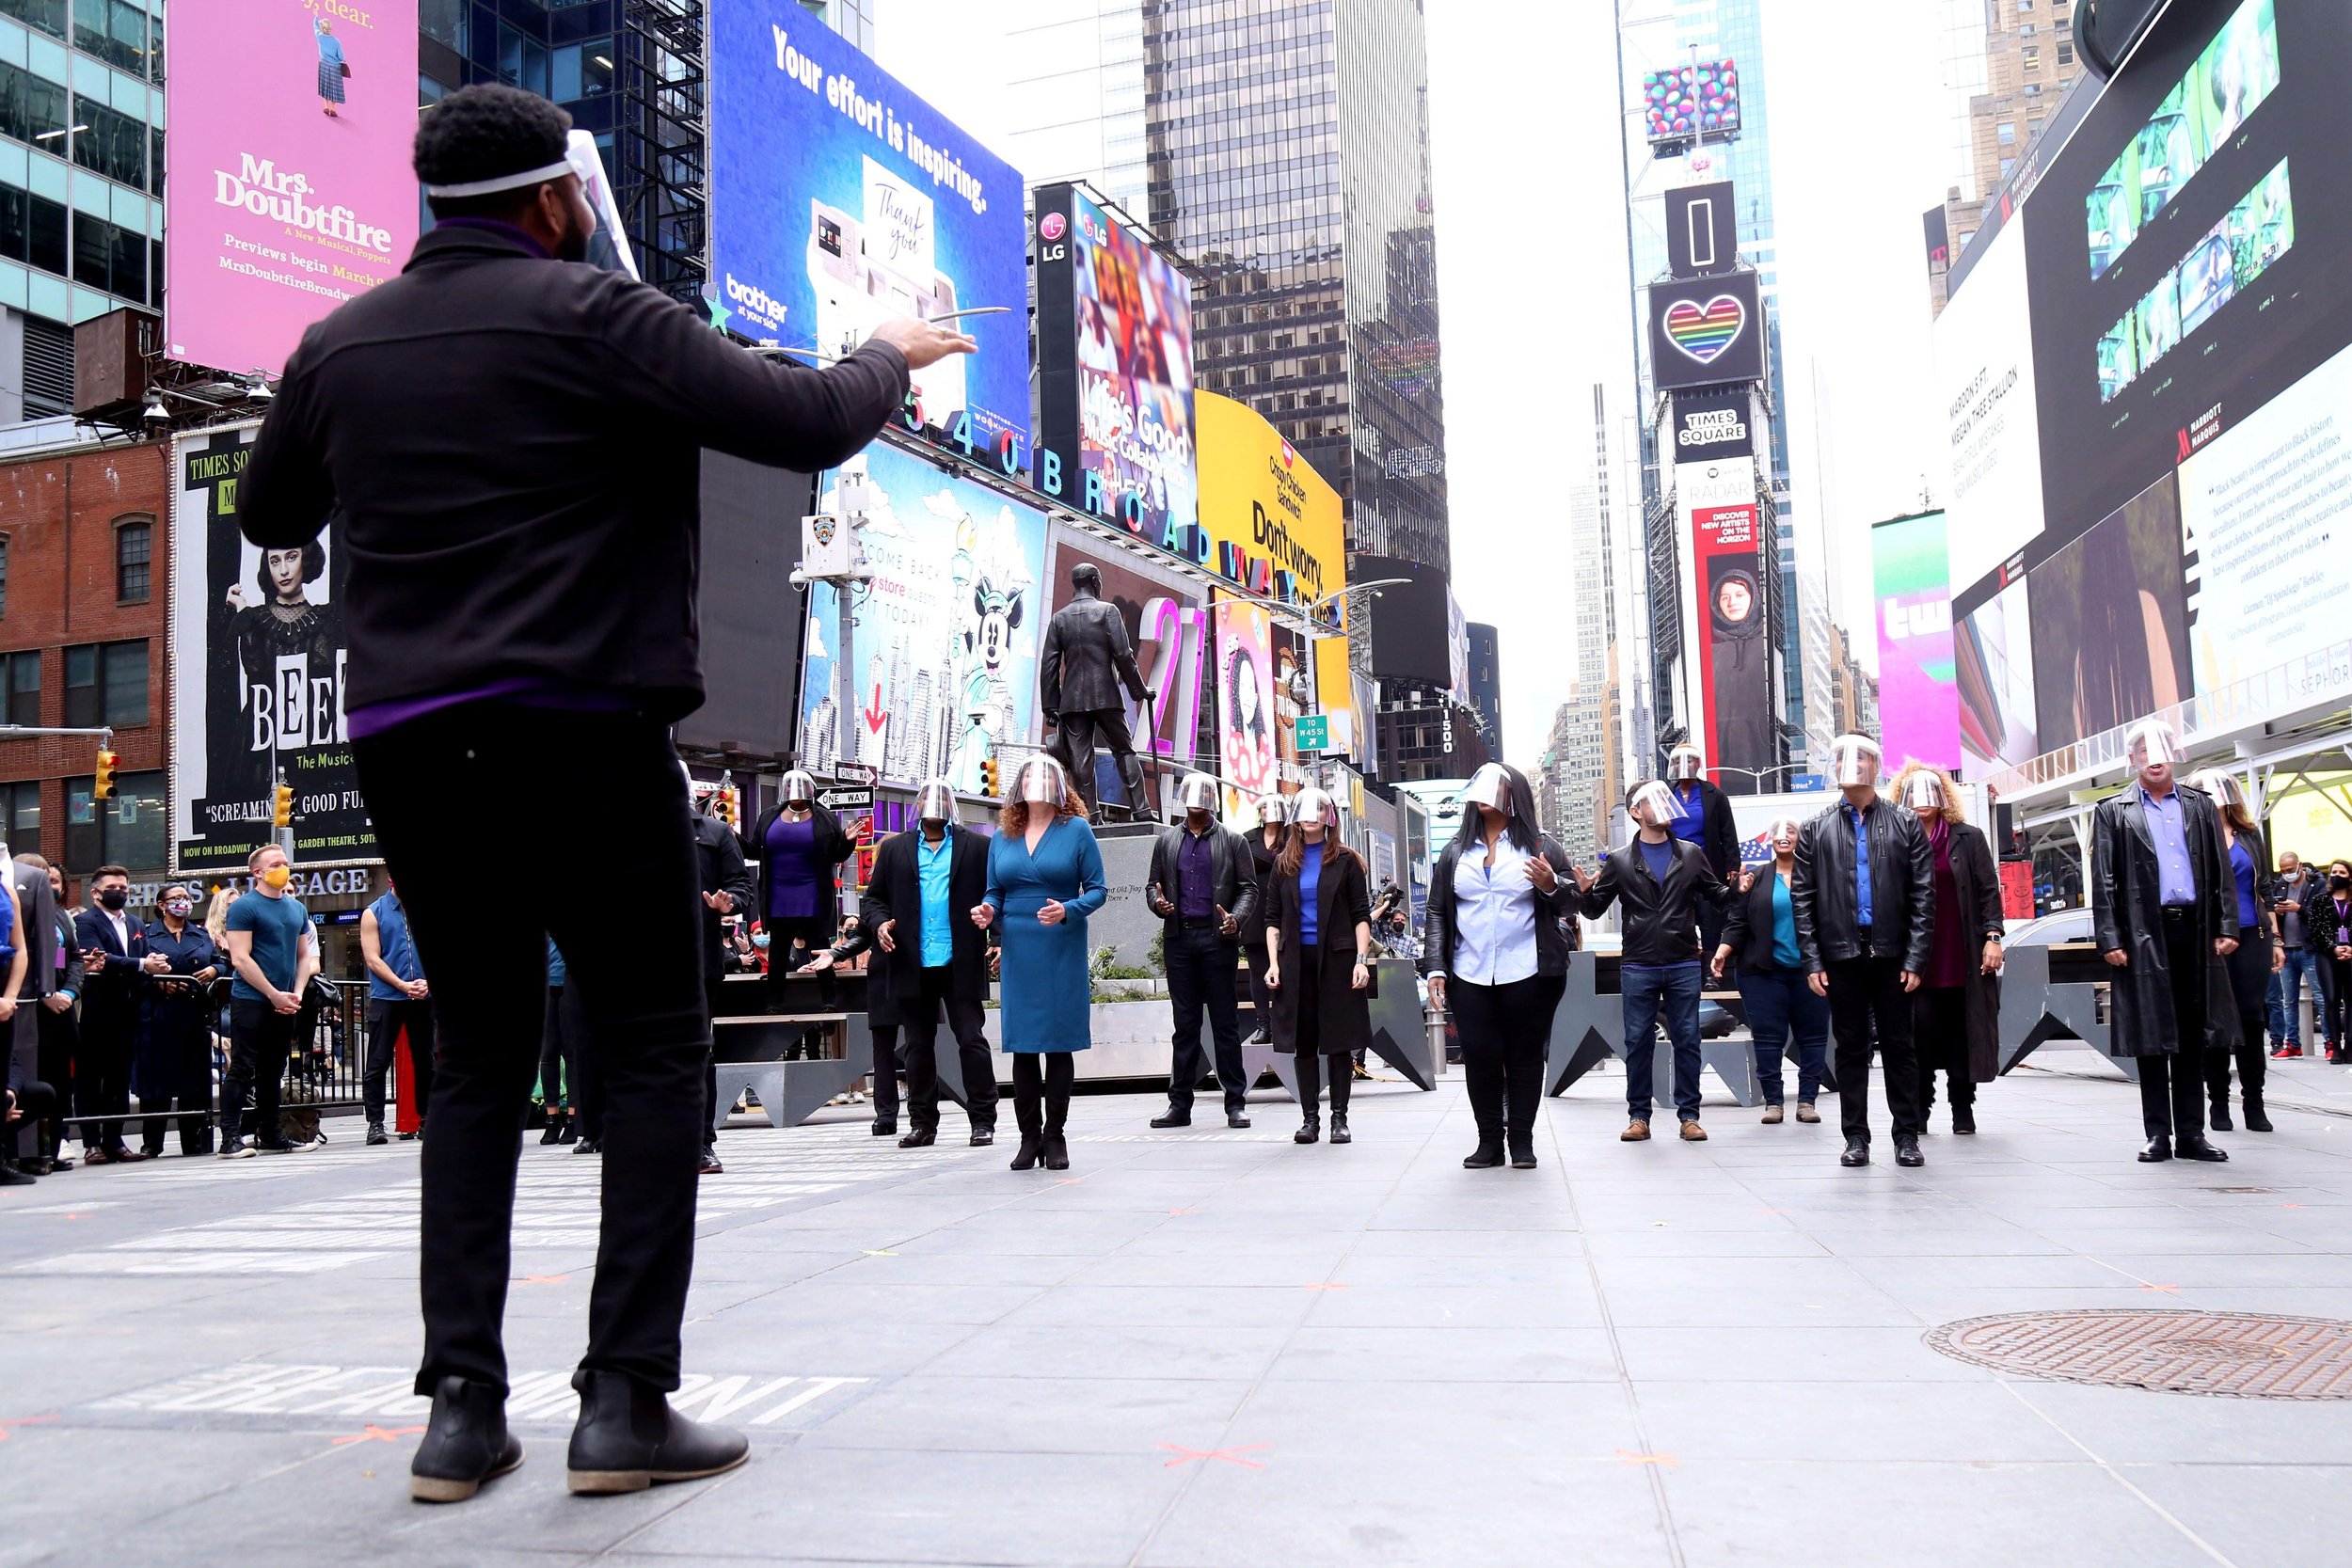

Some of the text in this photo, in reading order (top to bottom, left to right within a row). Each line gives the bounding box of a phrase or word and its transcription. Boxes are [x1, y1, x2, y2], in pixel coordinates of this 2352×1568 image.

[325, 0, 374, 29] dear.
[772, 24, 986, 214] Your effort is inspiring.
[240, 152, 314, 195] Mrs.
[2012, 150, 2039, 196] MARRIOTT
[2013, 172, 2037, 208] MARQUIS
[215, 169, 391, 253] Doubtfire
[875, 183, 925, 231] Thank
[294, 230, 314, 243] New
[357, 248, 391, 264] Poppets
[890, 228, 920, 259] you
[1094, 224, 1107, 246] LG
[224, 233, 374, 287] Previews begin March
[1042, 245, 1064, 261] LG
[726, 273, 787, 323] brother
[738, 307, 746, 316] at
[1949, 366, 1989, 421] MAROON 5 FT.
[1951, 364, 2018, 449] MEGAN THEE STALLION
[1083, 370, 1188, 467] Life's Good
[1689, 412, 1735, 426] TIMES
[2190, 402, 2221, 434] MARRIOTT
[2310, 416, 2333, 437] history
[1682, 427, 1742, 443] SQUARE
[2191, 420, 2219, 449] MARQUIS
[191, 453, 230, 481] TIMES
[1084, 414, 1118, 452] Music
[1120, 436, 1189, 490] Collaboration
[1270, 456, 1307, 505] Crispy Chicken
[1690, 481, 1749, 501] RADAR
[1277, 485, 1301, 522] Sandwich
[1712, 511, 1750, 520] DISCOVER
[1043, 448, 1295, 604] BROADWAY
[1717, 534, 1751, 544] HORIZON
[1721, 519, 1750, 528] ARTISTS
[867, 545, 940, 582] COME BACK
[1253, 500, 1324, 596] Don't worry,
[878, 576, 905, 596] store
[908, 589, 936, 607] GUESTS
[1442, 708, 1453, 753] 1500
[296, 756, 314, 769] The
[841, 769, 871, 781] ONE WAY
[302, 793, 337, 814] GOOD
[823, 793, 866, 804] ONE WAY
[1438, 801, 1459, 813] abc
[183, 847, 201, 858] NOW
[202, 846, 213, 856] ON
[214, 843, 251, 855] BROADWAY
[298, 836, 326, 849] GARDEN
[327, 834, 358, 847] THEATRE,
